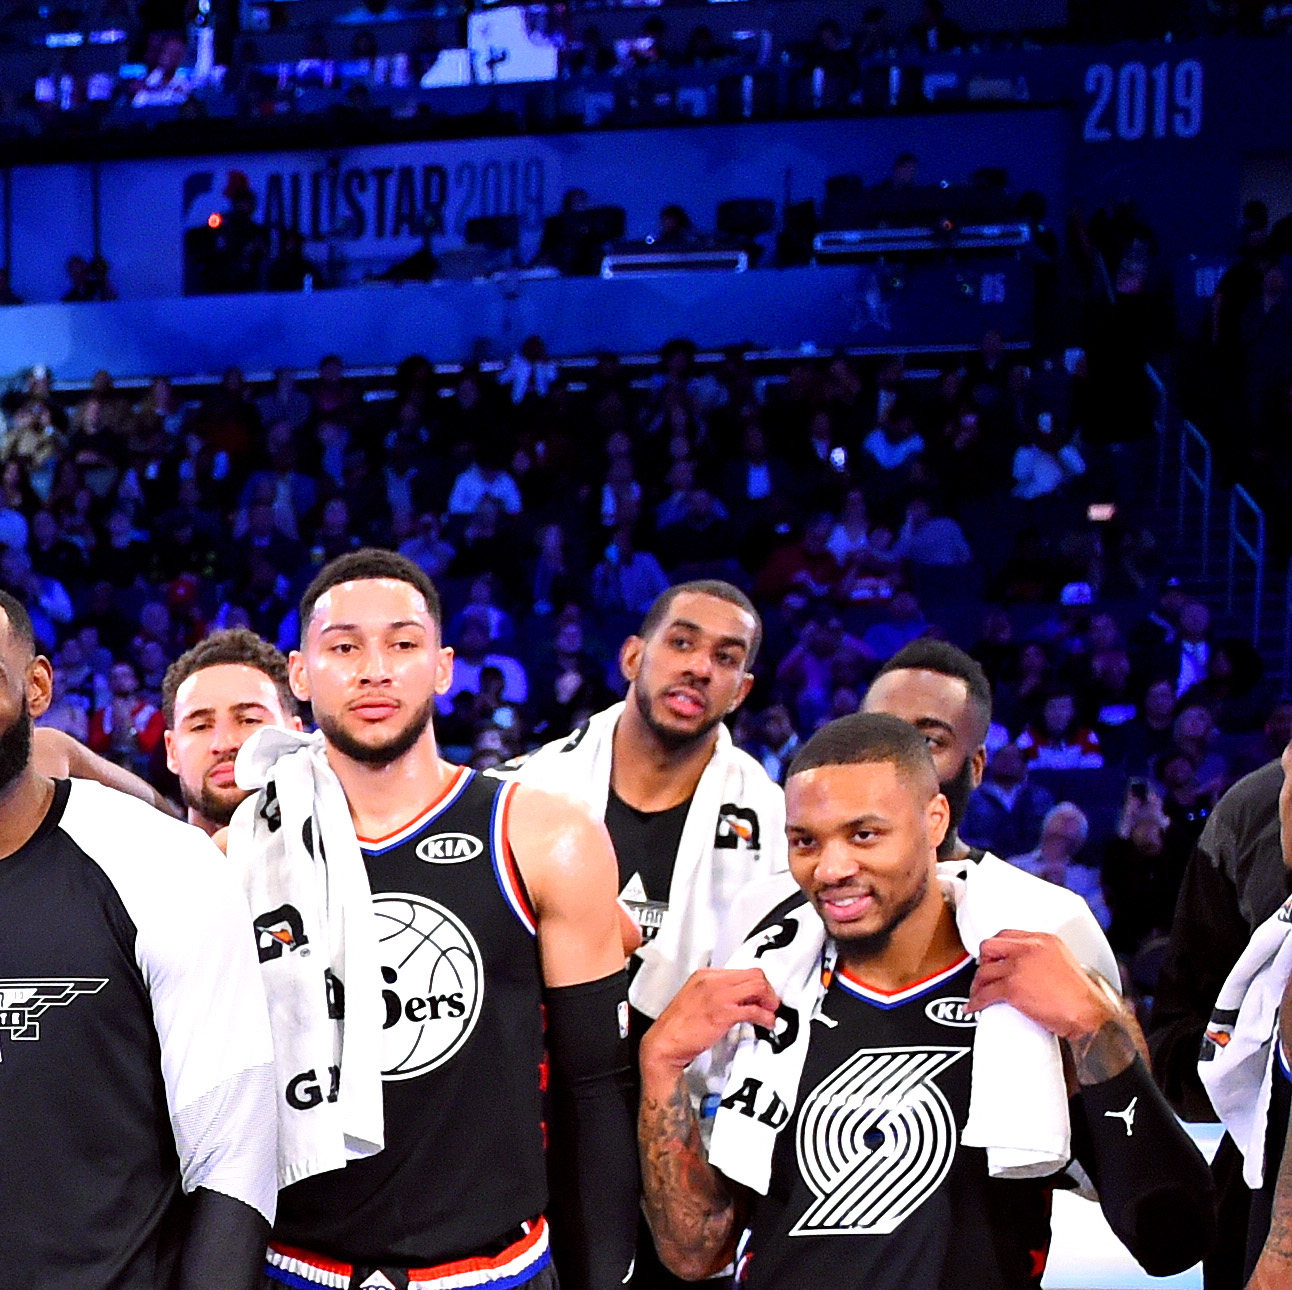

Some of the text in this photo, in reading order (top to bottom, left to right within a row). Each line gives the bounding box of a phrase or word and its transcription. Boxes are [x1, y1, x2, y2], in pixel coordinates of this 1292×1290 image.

[1083, 58, 1204, 143] 2019
[343, 163, 449, 239] STAR
[427, 840, 472, 859] KIA
